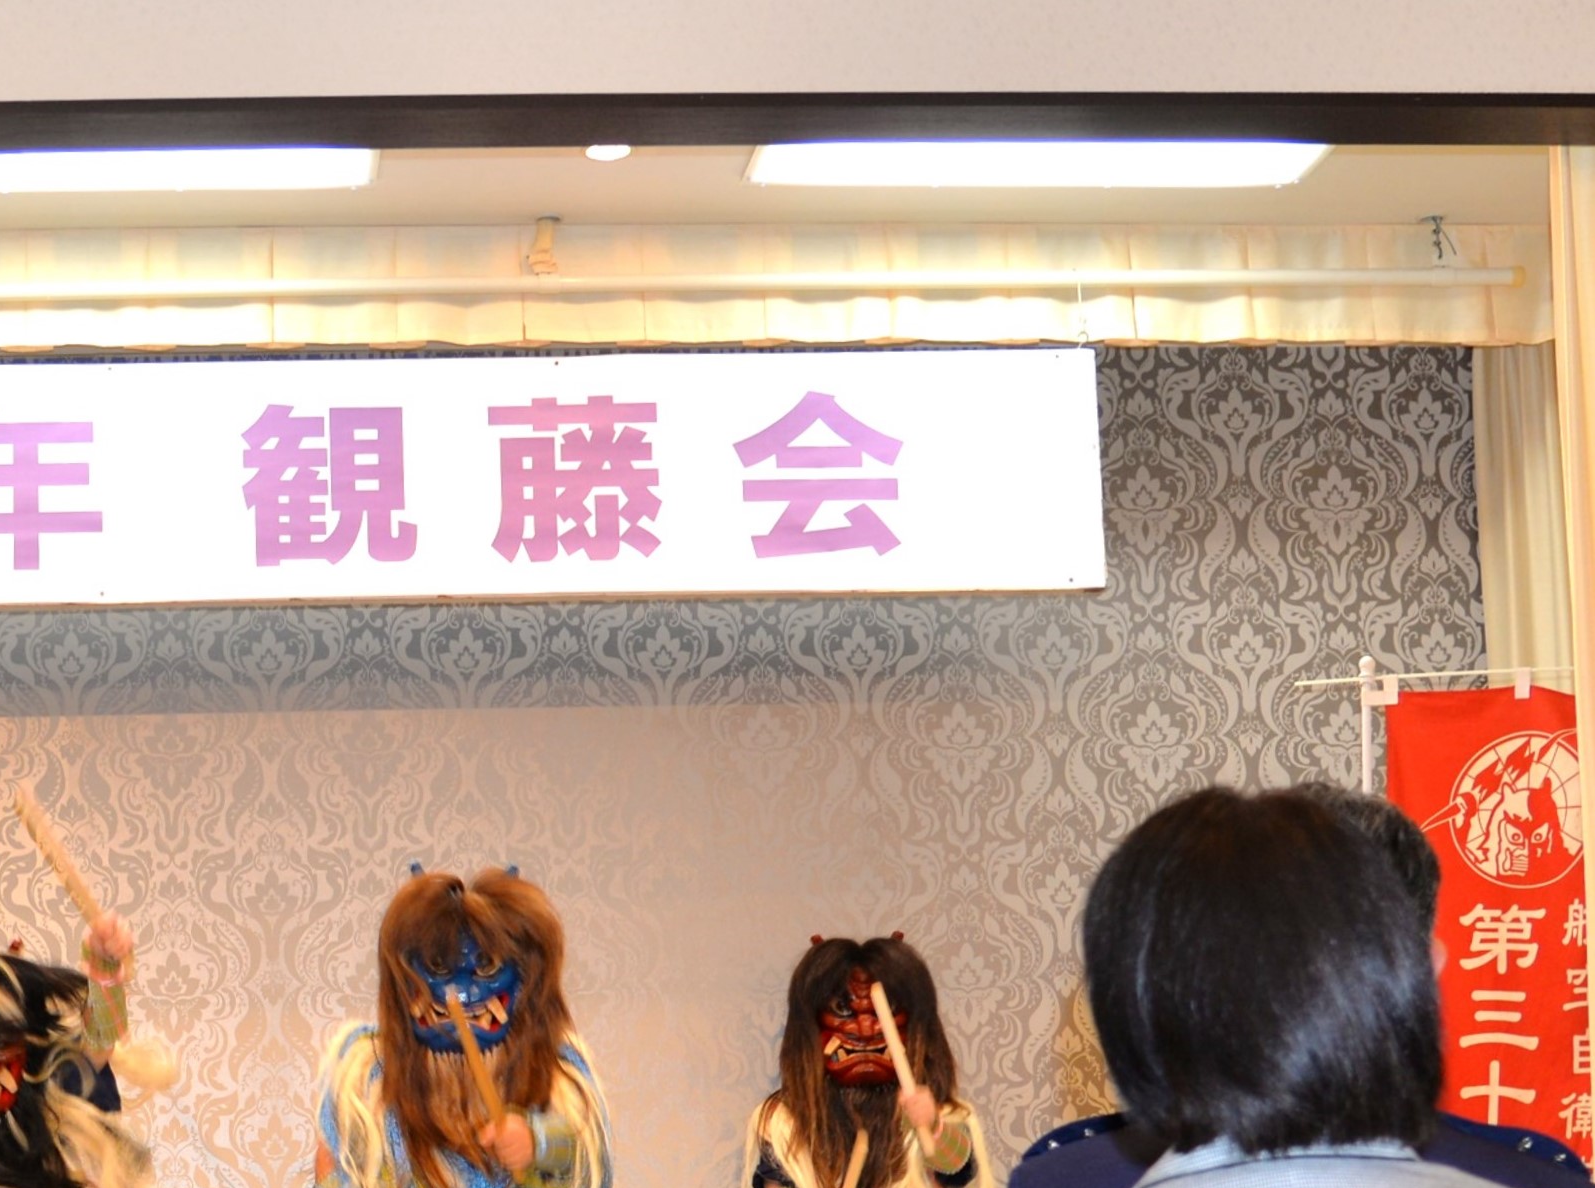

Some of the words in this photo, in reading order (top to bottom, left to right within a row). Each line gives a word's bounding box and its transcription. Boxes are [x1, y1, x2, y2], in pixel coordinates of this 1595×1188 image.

[241, 391, 904, 567] 観藤会
[1459, 903, 1546, 1125] 第三十
